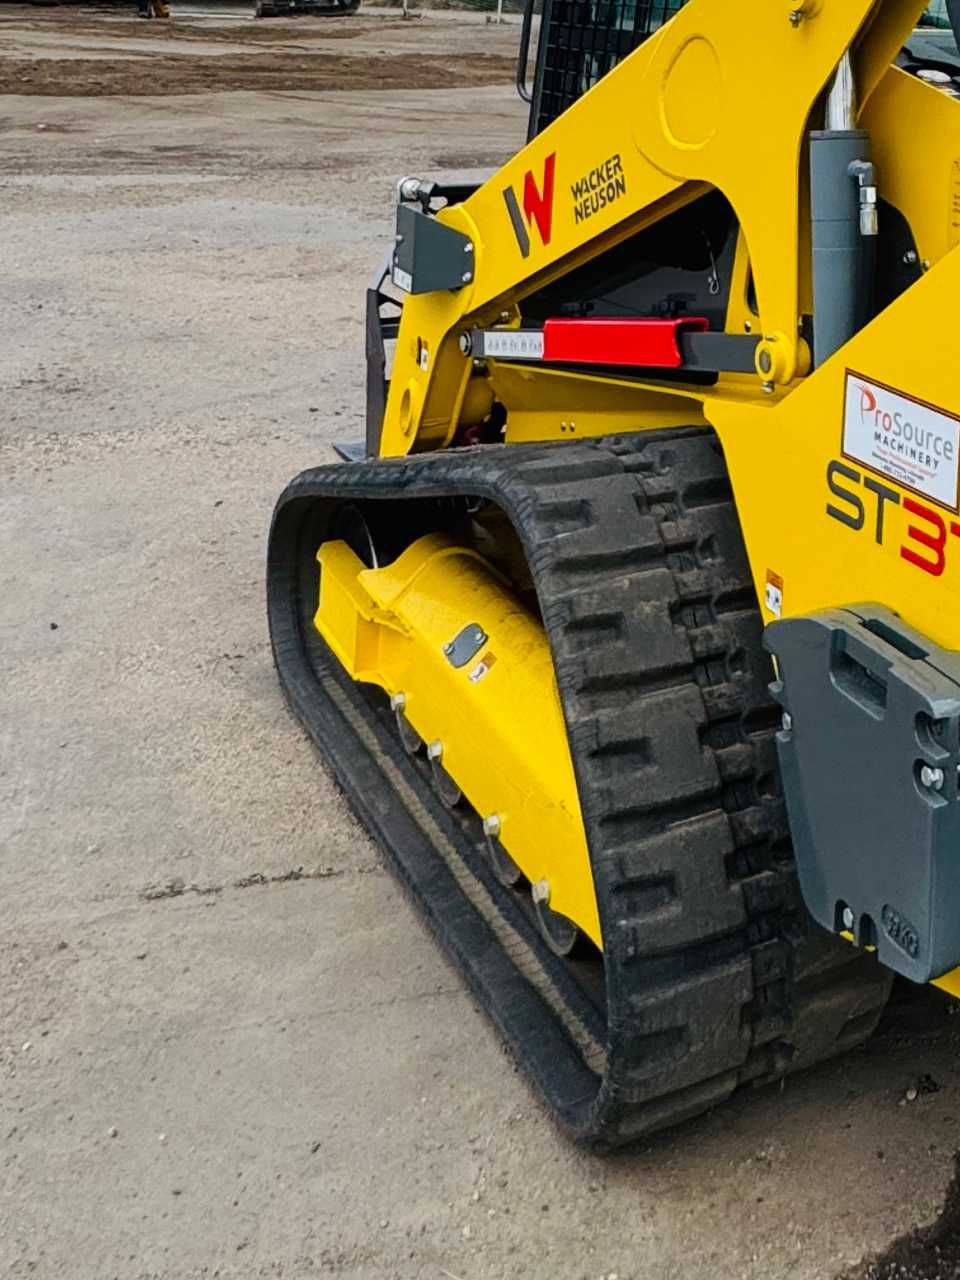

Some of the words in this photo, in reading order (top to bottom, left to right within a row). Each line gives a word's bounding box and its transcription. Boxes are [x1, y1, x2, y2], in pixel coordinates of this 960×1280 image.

[570, 153, 623, 203] WACKER
[574, 174, 626, 225] NEUSON
[853, 381, 954, 461] ProSource
[874, 431, 940, 470] MACHINERY
